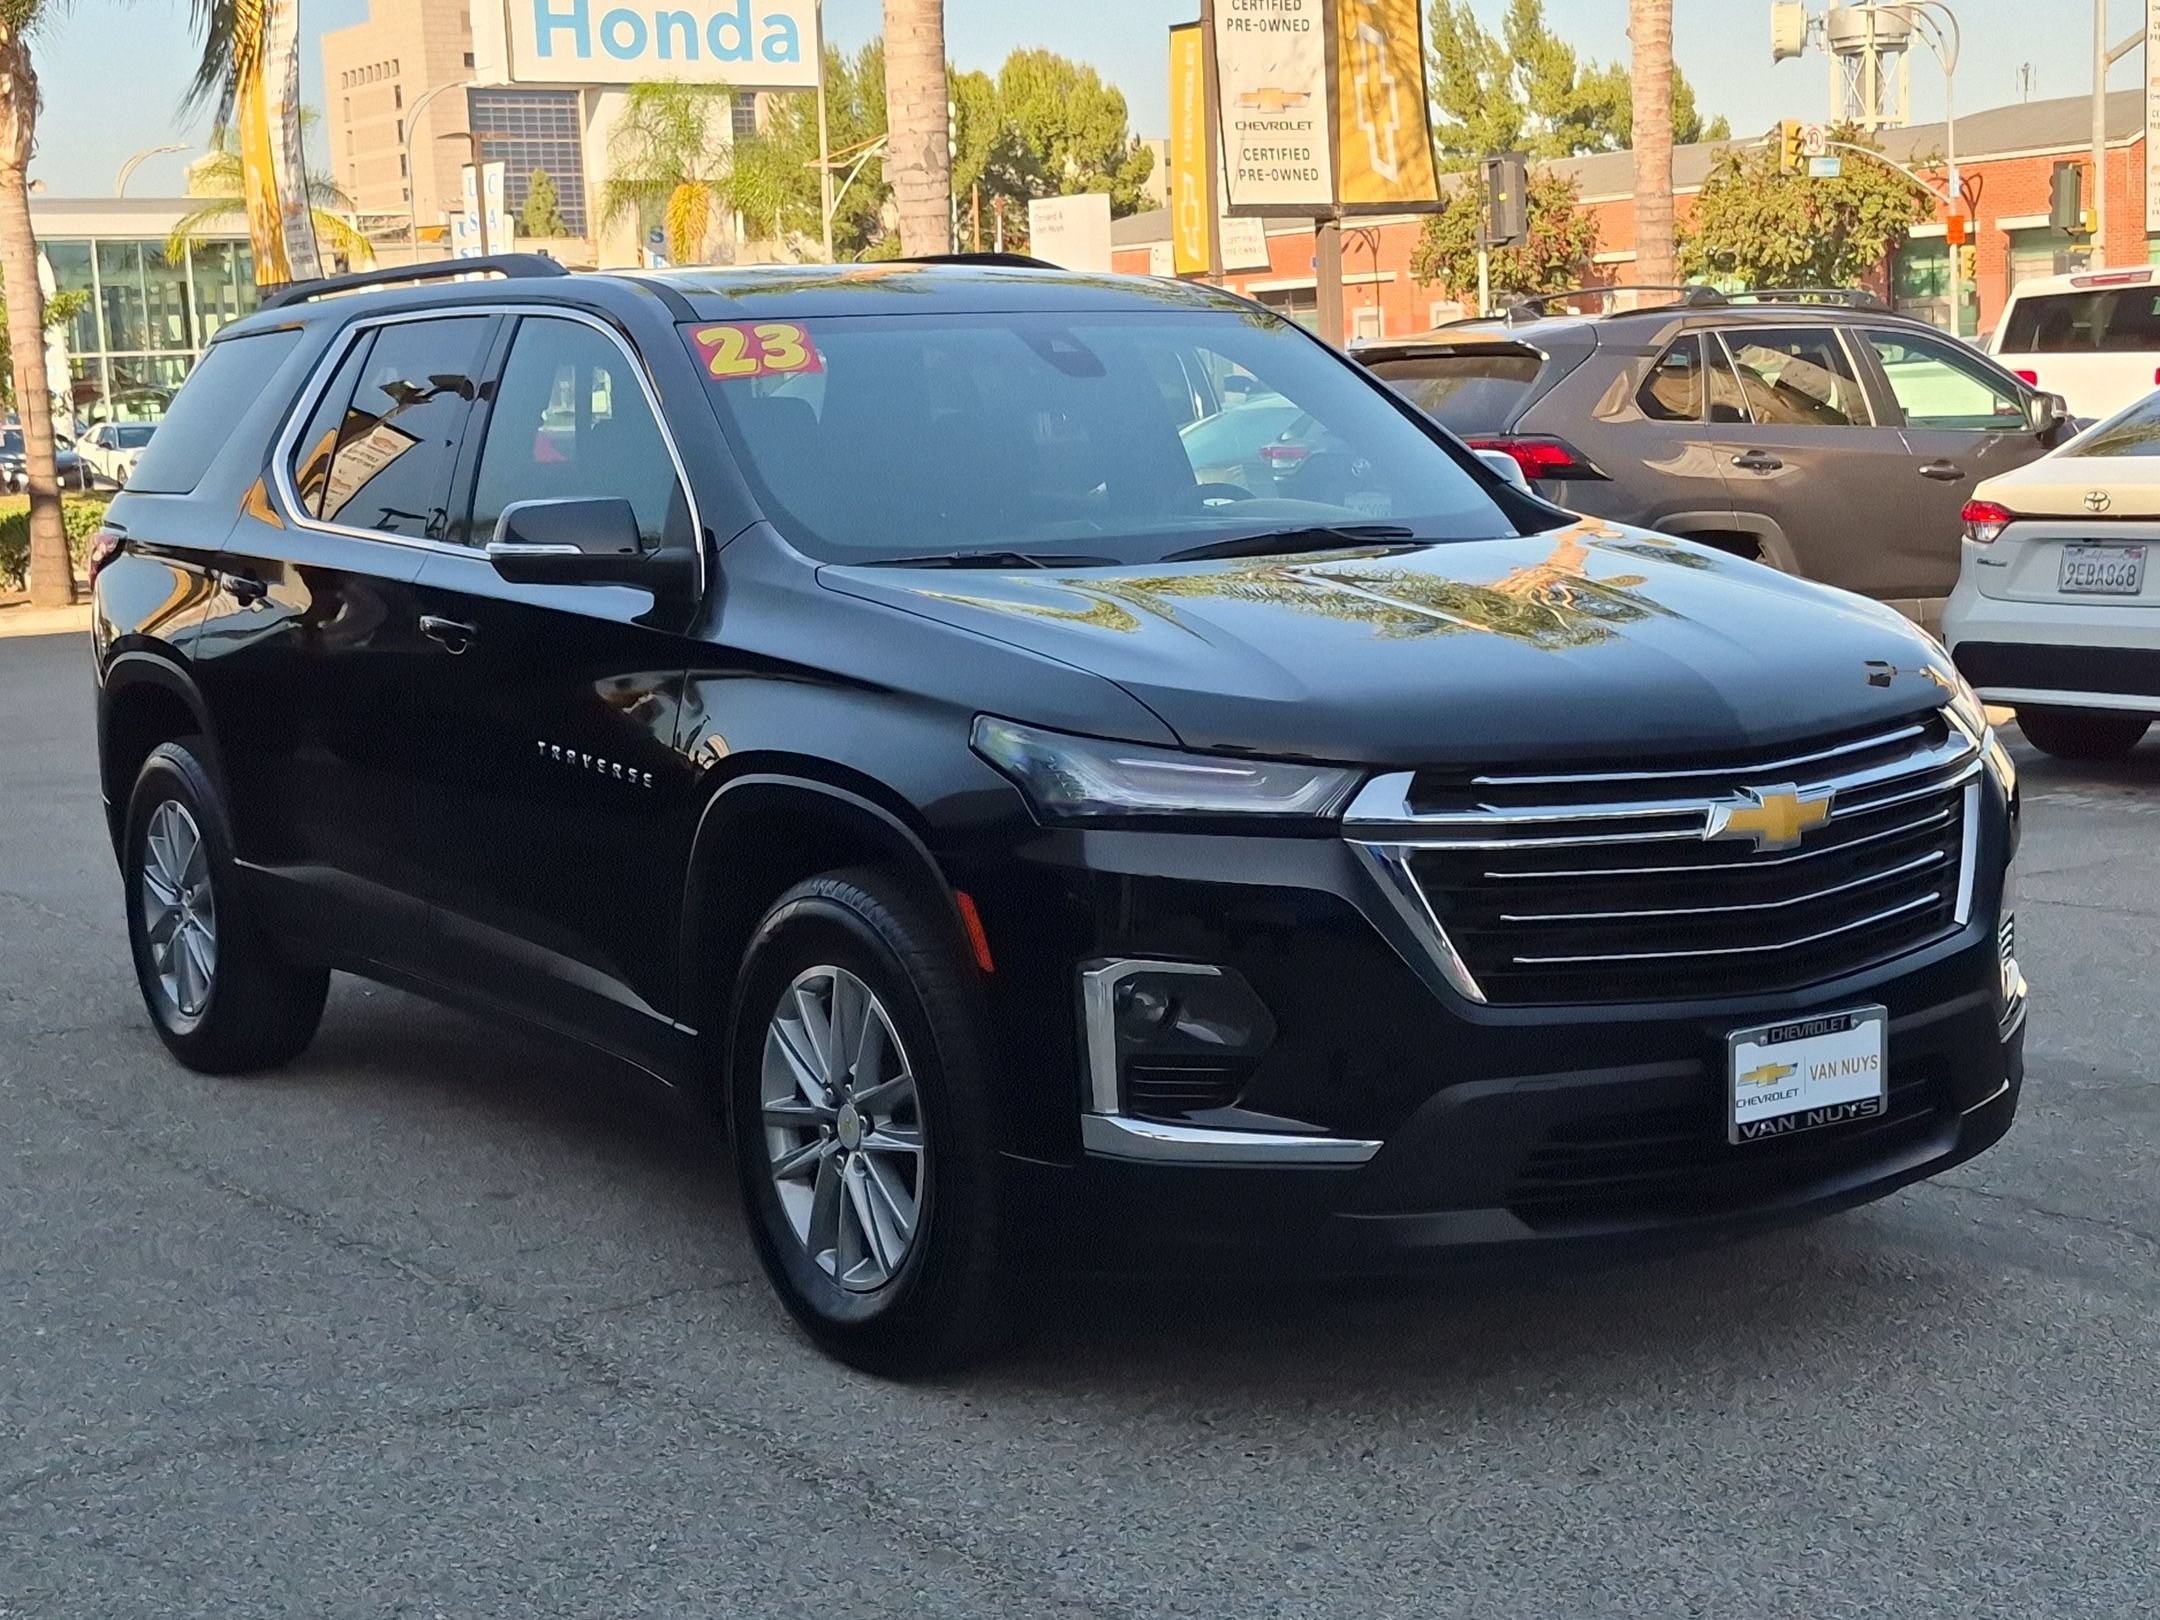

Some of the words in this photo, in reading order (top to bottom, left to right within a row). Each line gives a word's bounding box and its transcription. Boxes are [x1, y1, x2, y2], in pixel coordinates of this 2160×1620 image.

[1232, 0, 1301, 11] CERTIFIED
[532, 0, 800, 63] Honda
[1226, 18, 1310, 32] PRE-OWNED
[1235, 121, 1313, 131] CHEVROLET
[1243, 148, 1310, 161] CERTIFIED
[1239, 168, 1319, 181] PRE-OWNED
[696, 324, 811, 376] 23
[2064, 563, 2137, 586] 9EBA868
[537, 740, 653, 789] TRAVERSE
[1771, 1016, 1847, 1043] CHEVROLET
[1810, 1061, 1837, 1081] VAN
[1841, 1054, 1878, 1075] NUYS
[1736, 1088, 1799, 1108] CHEVROLET
[1740, 1115, 1795, 1139] VAN
[1807, 1099, 1878, 1126] NUYS
